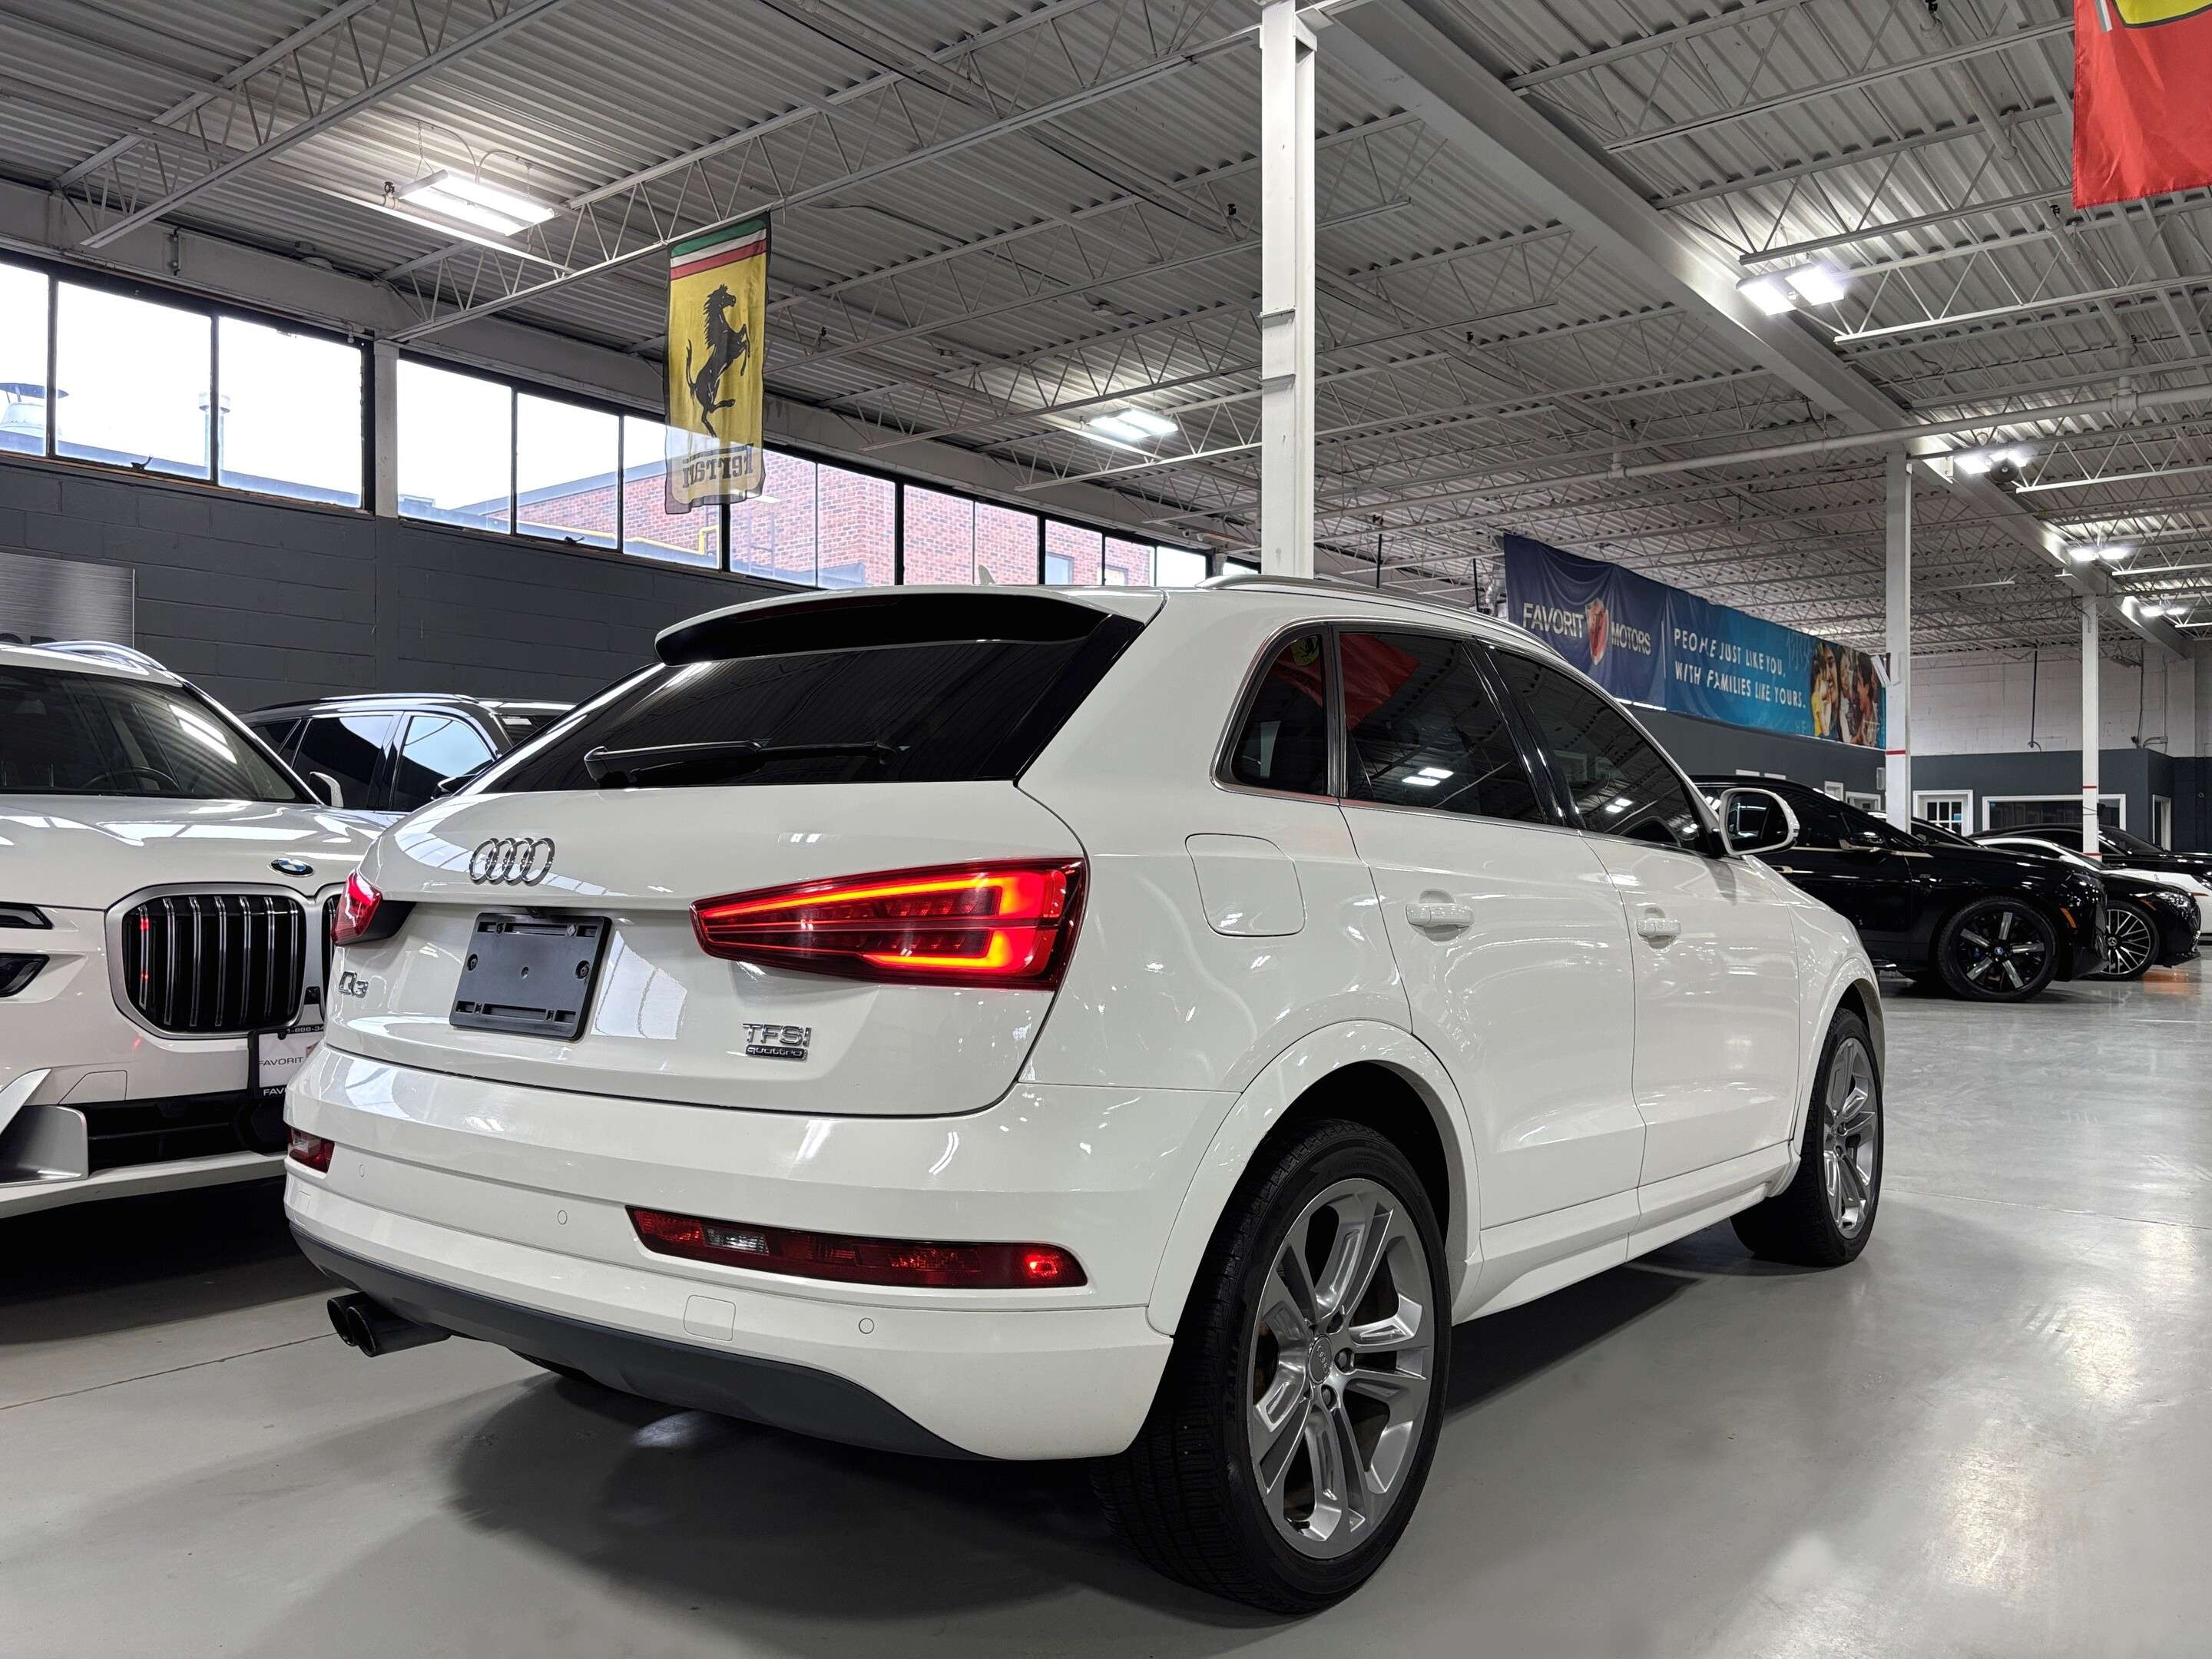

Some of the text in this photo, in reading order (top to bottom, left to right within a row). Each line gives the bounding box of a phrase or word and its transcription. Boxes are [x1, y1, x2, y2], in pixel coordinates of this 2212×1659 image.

[1522, 602, 1651, 655] FAVORIT MOTORS
[1719, 642, 1741, 664] JUST
[1745, 649, 1763, 670] LIKE
[1675, 661, 1806, 708] WITH FAMILIES LIKE YOURS.
[339, 971, 369, 998] Q3
[742, 1023, 812, 1047] TFSI
[747, 1046, 803, 1056] quattro
